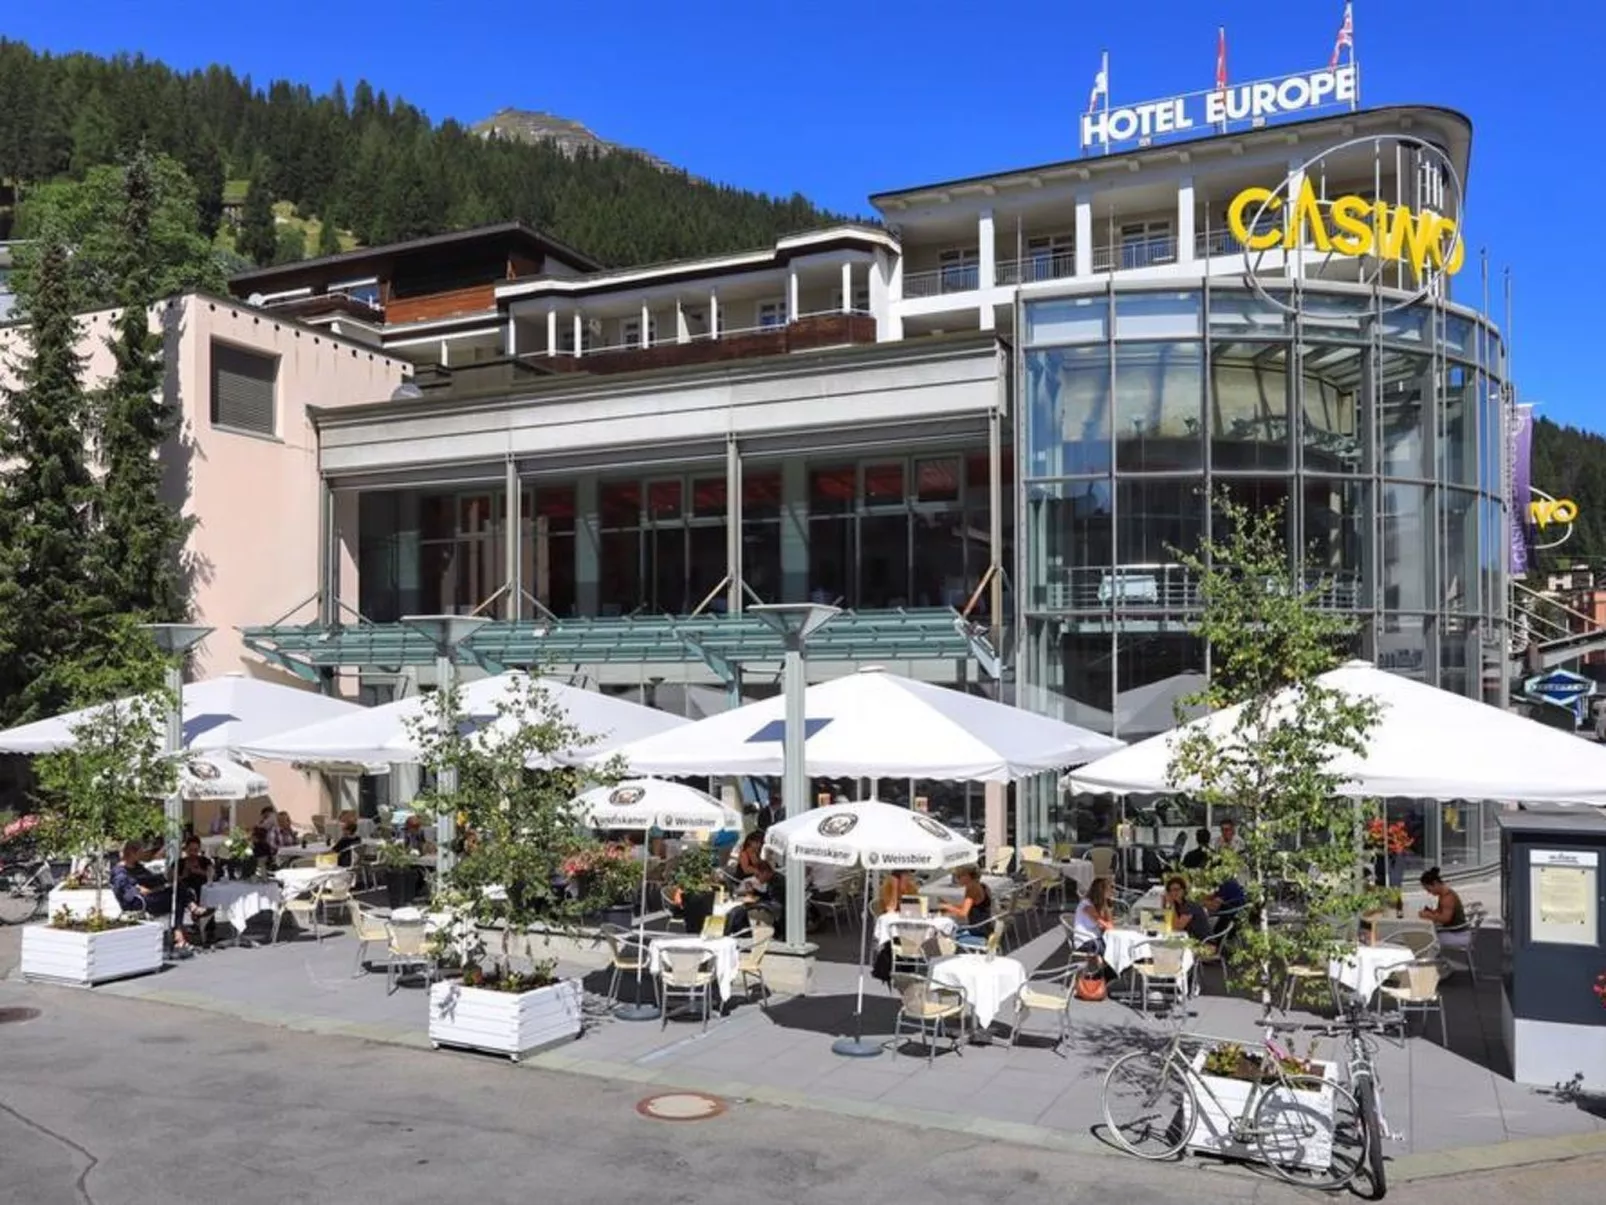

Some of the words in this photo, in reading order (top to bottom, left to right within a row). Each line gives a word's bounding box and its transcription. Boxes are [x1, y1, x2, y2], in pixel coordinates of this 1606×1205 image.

[1082, 98, 1192, 145] HOTEL
[1205, 67, 1356, 124] EUROPE
[1227, 175, 1465, 284] CASINO
[882, 852, 932, 864] Weissbier
